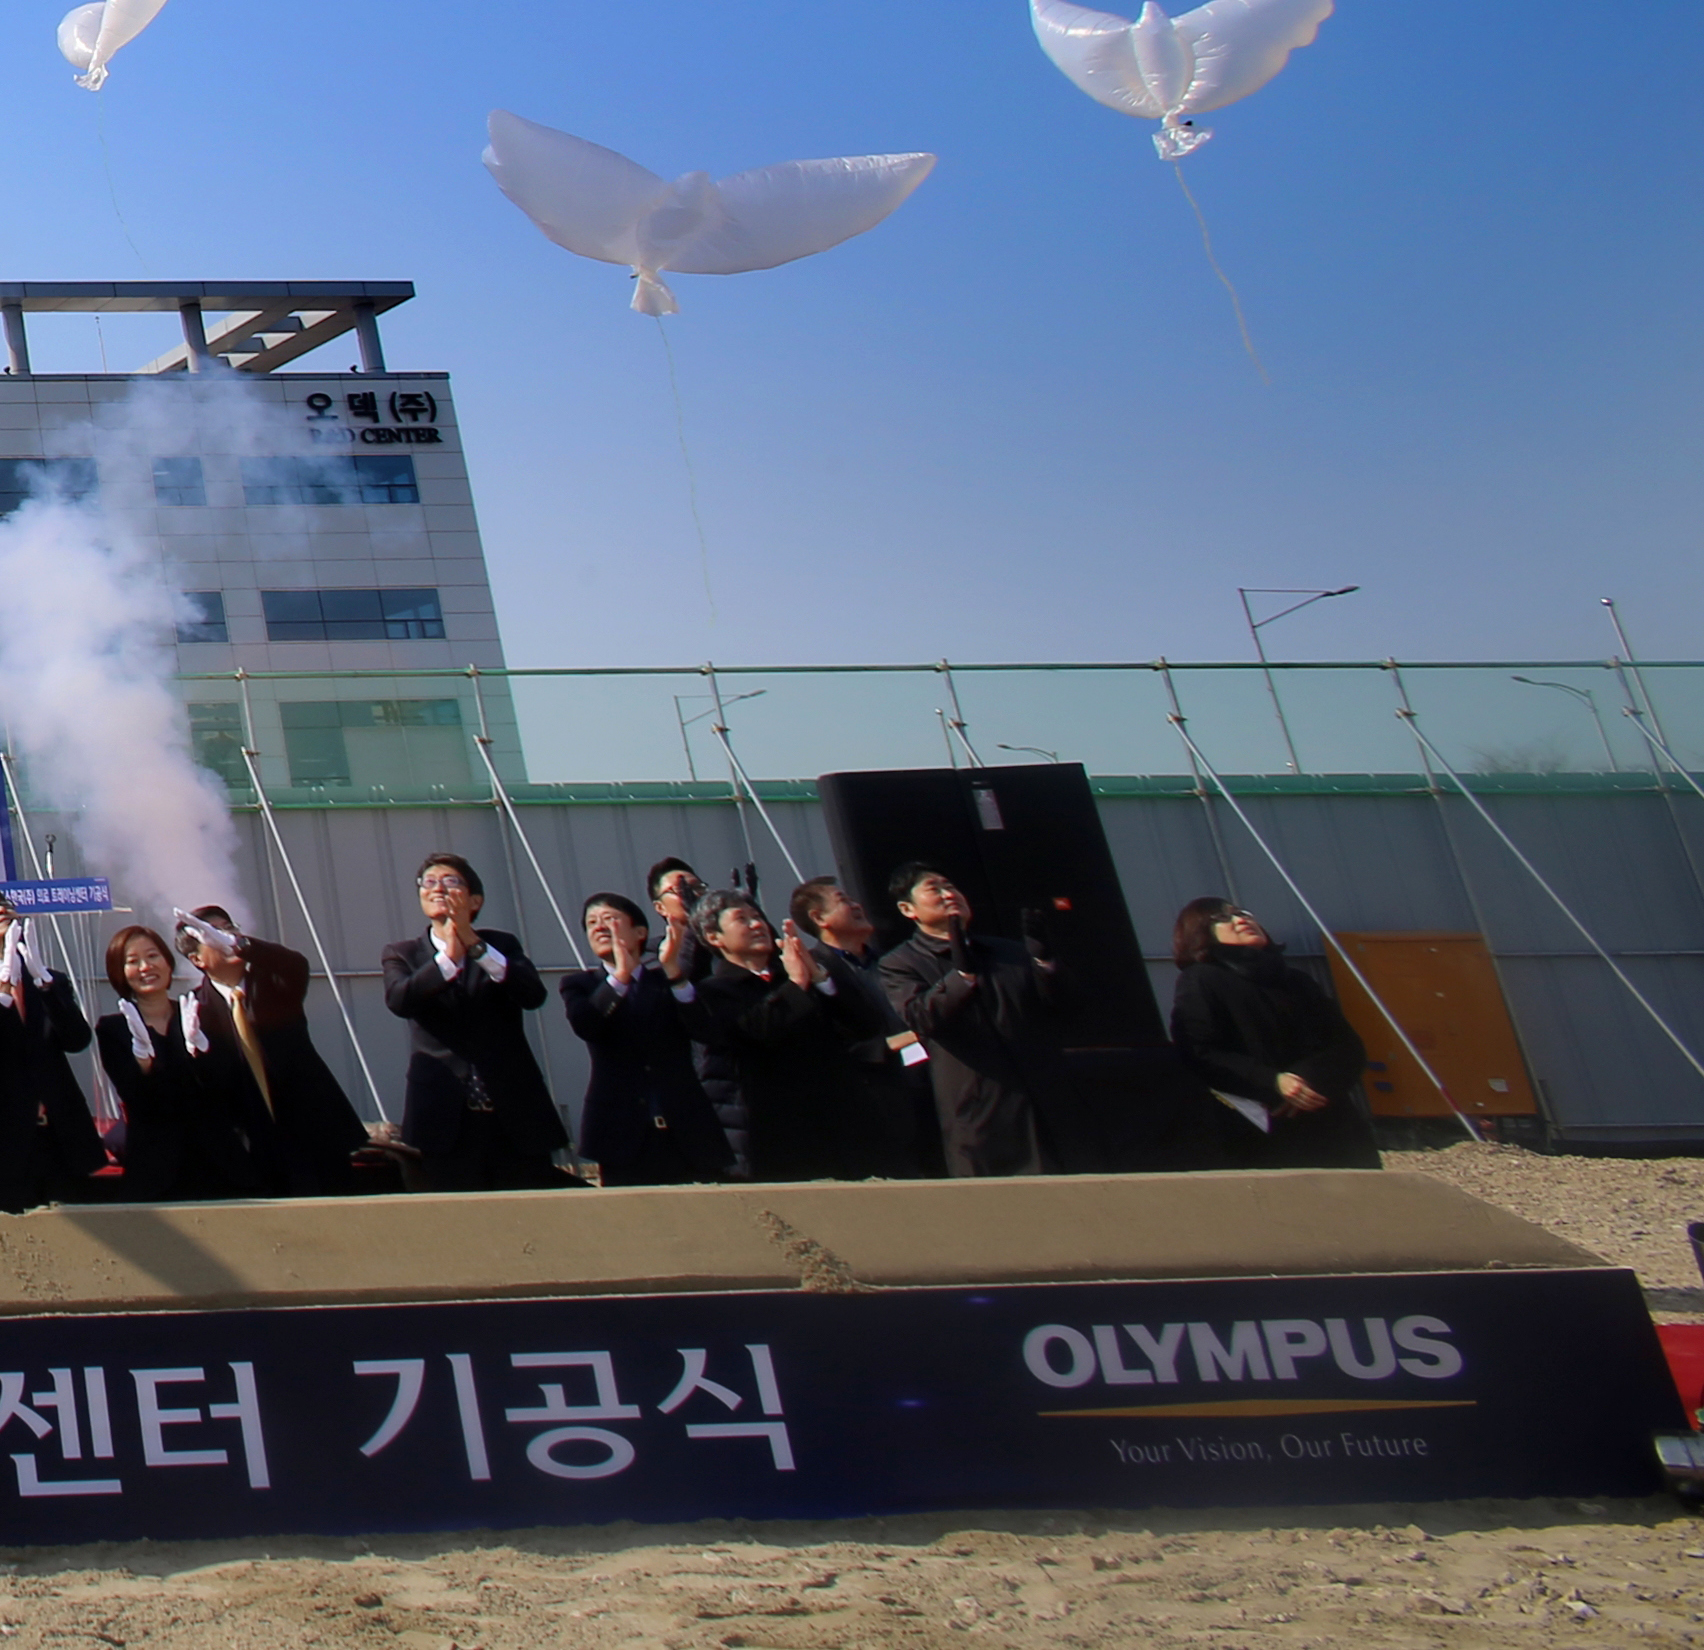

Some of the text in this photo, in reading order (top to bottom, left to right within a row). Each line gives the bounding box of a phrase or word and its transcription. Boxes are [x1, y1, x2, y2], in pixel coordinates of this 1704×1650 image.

[310, 427, 443, 444] RD CENTER
[1023, 1314, 1464, 1389] OLYMPUS
[352, 1344, 796, 1482] 기공식
[1110, 1431, 1429, 1465] Your Vision, Our Future
